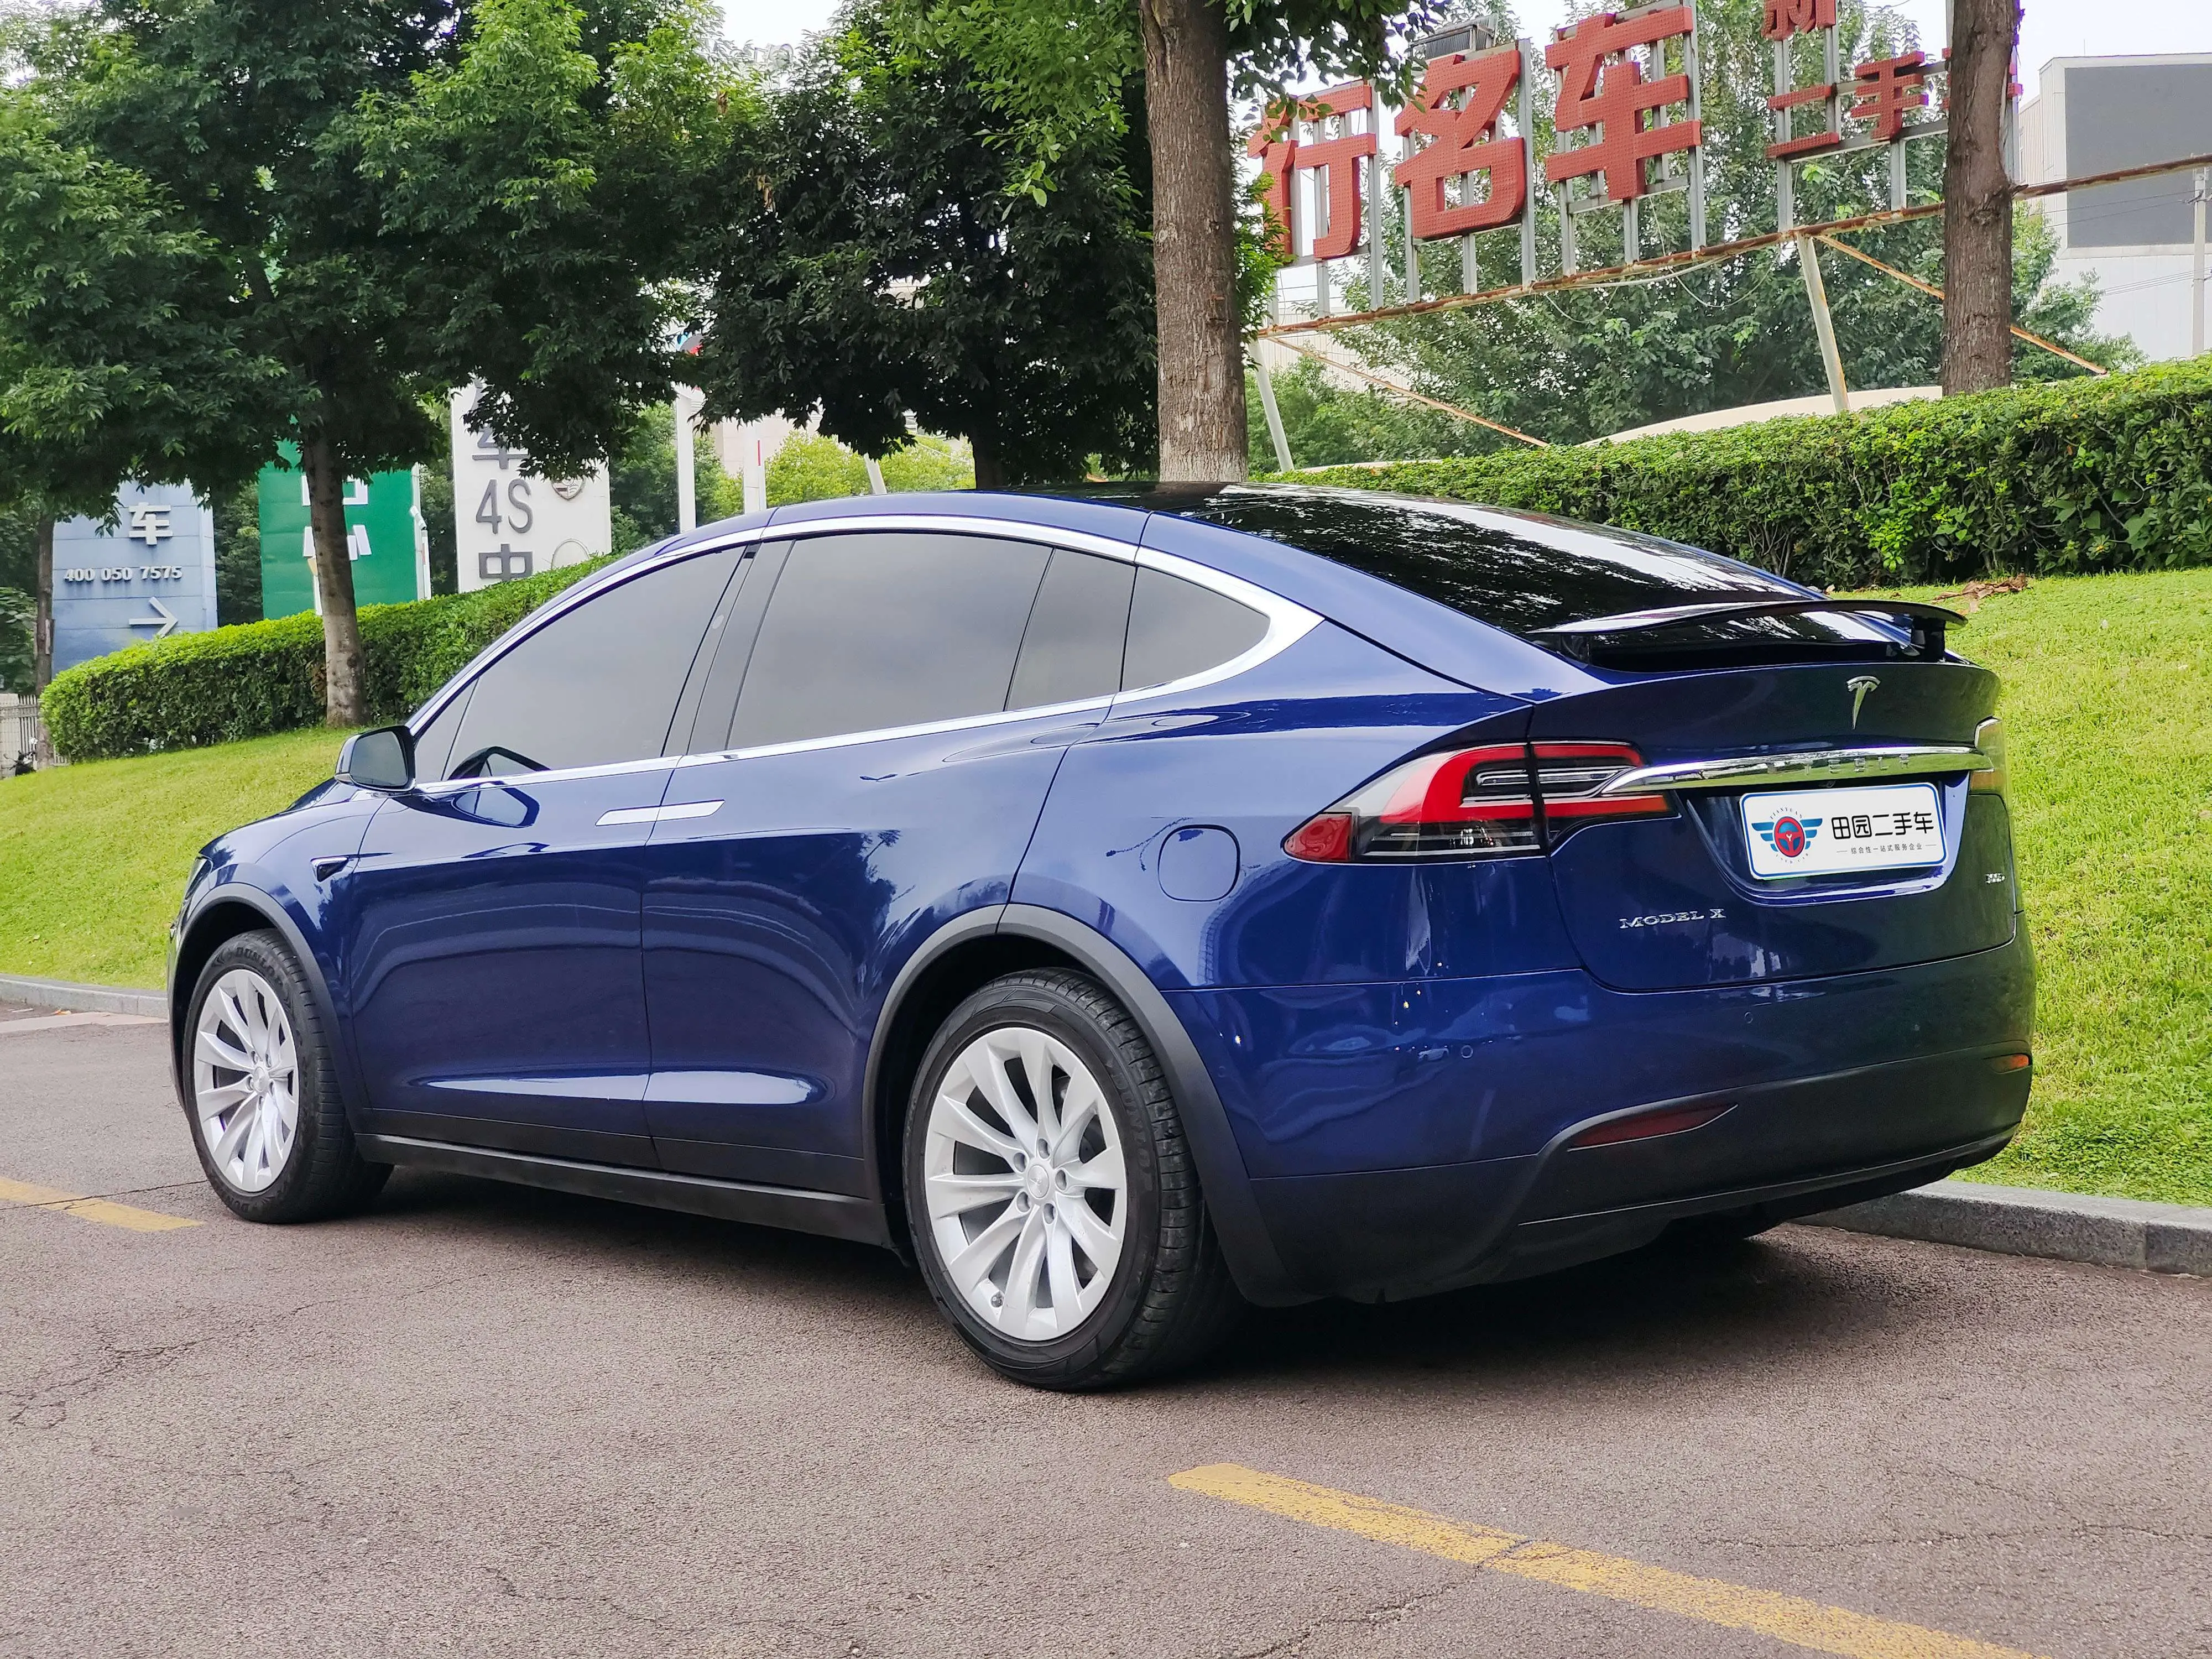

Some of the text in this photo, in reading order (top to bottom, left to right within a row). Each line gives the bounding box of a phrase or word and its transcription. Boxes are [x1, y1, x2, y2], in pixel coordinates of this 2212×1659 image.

[129, 502, 173, 545] 车
[63, 566, 183, 582] 400 050 7575
[1803, 753, 1910, 775] TESLA
[1831, 811, 1934, 839] 田园二手车
[1851, 842, 1923, 855] 综合性一站式服务企业
[1619, 909, 1726, 928] MODEL X
